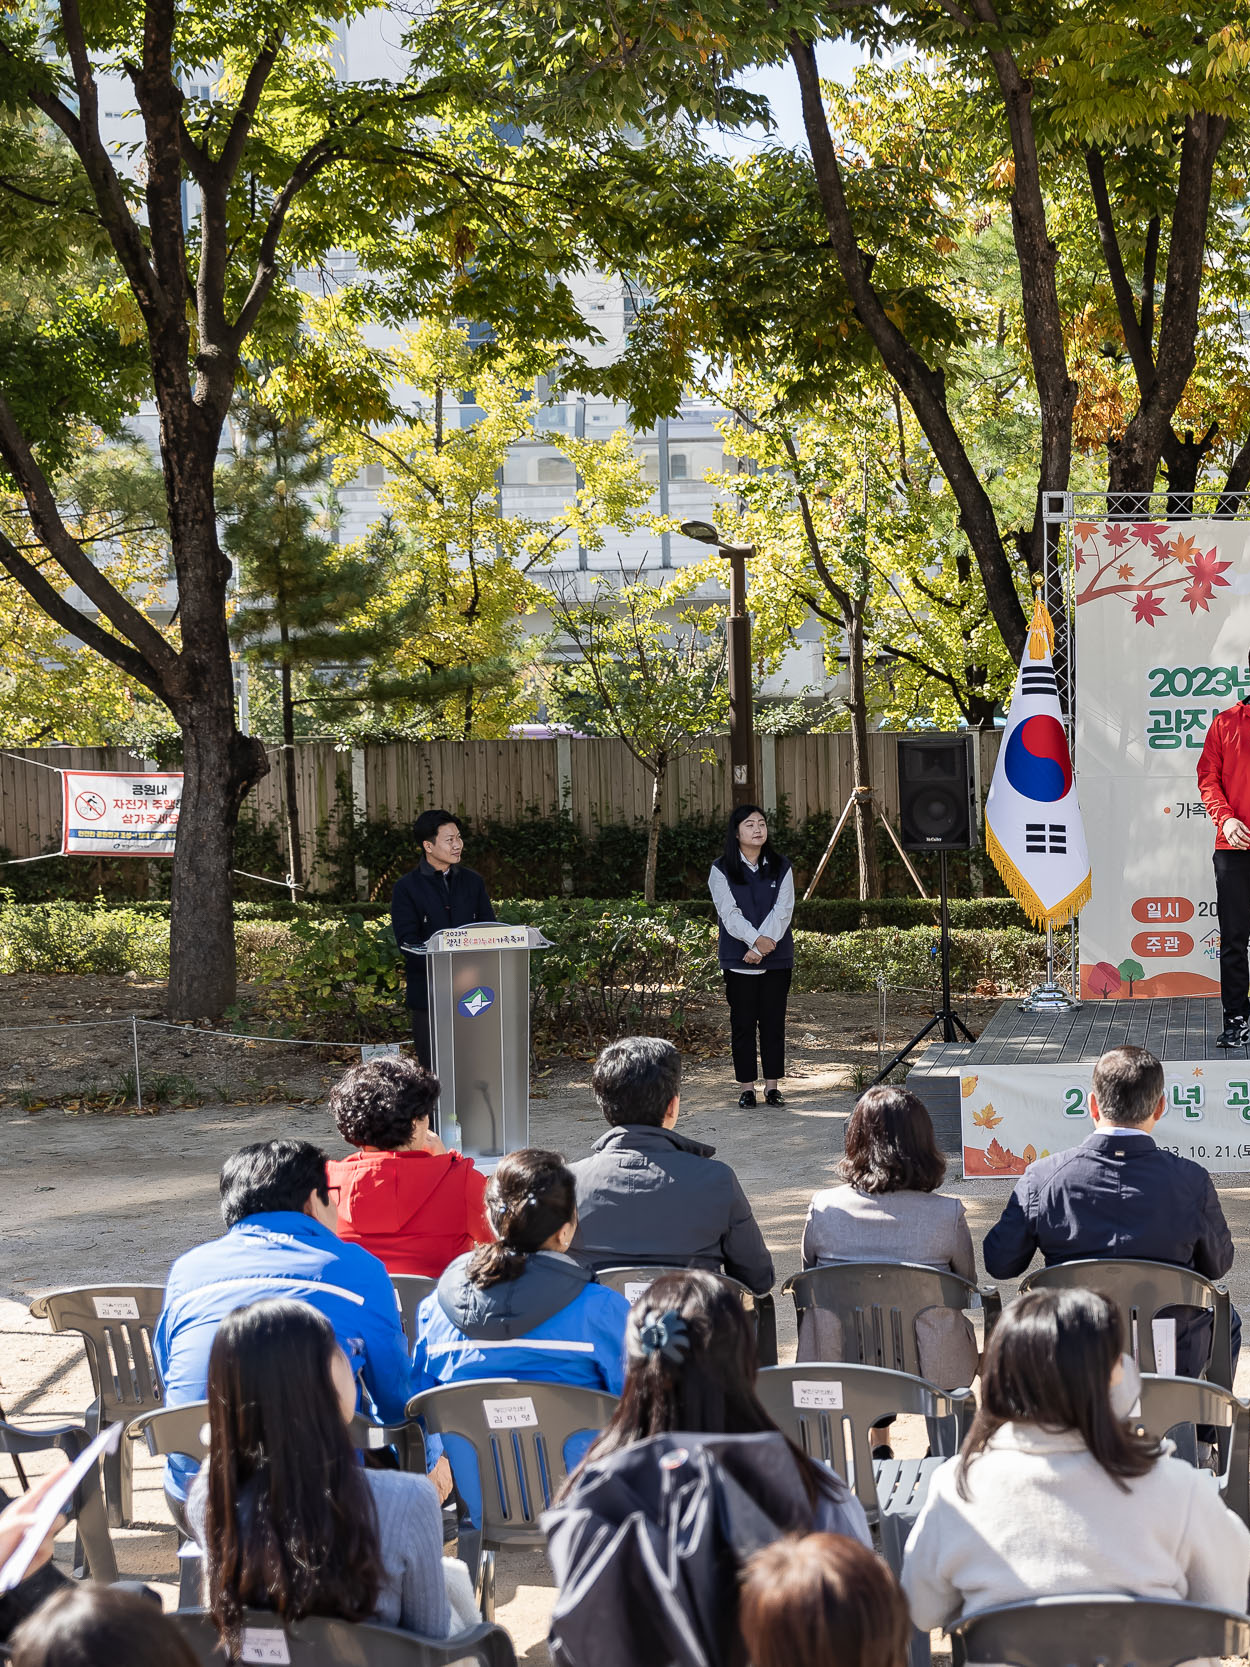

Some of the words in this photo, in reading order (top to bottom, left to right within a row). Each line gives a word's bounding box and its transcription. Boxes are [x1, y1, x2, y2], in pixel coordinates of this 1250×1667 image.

[132, 784, 168, 796] 공원내
[112, 799, 148, 810] 자전거
[121, 814, 179, 825] 삼가주세요
[1146, 902, 1180, 919] 일시
[1145, 936, 1180, 953] 주관
[1189, 1146, 1210, 1158] 10.
